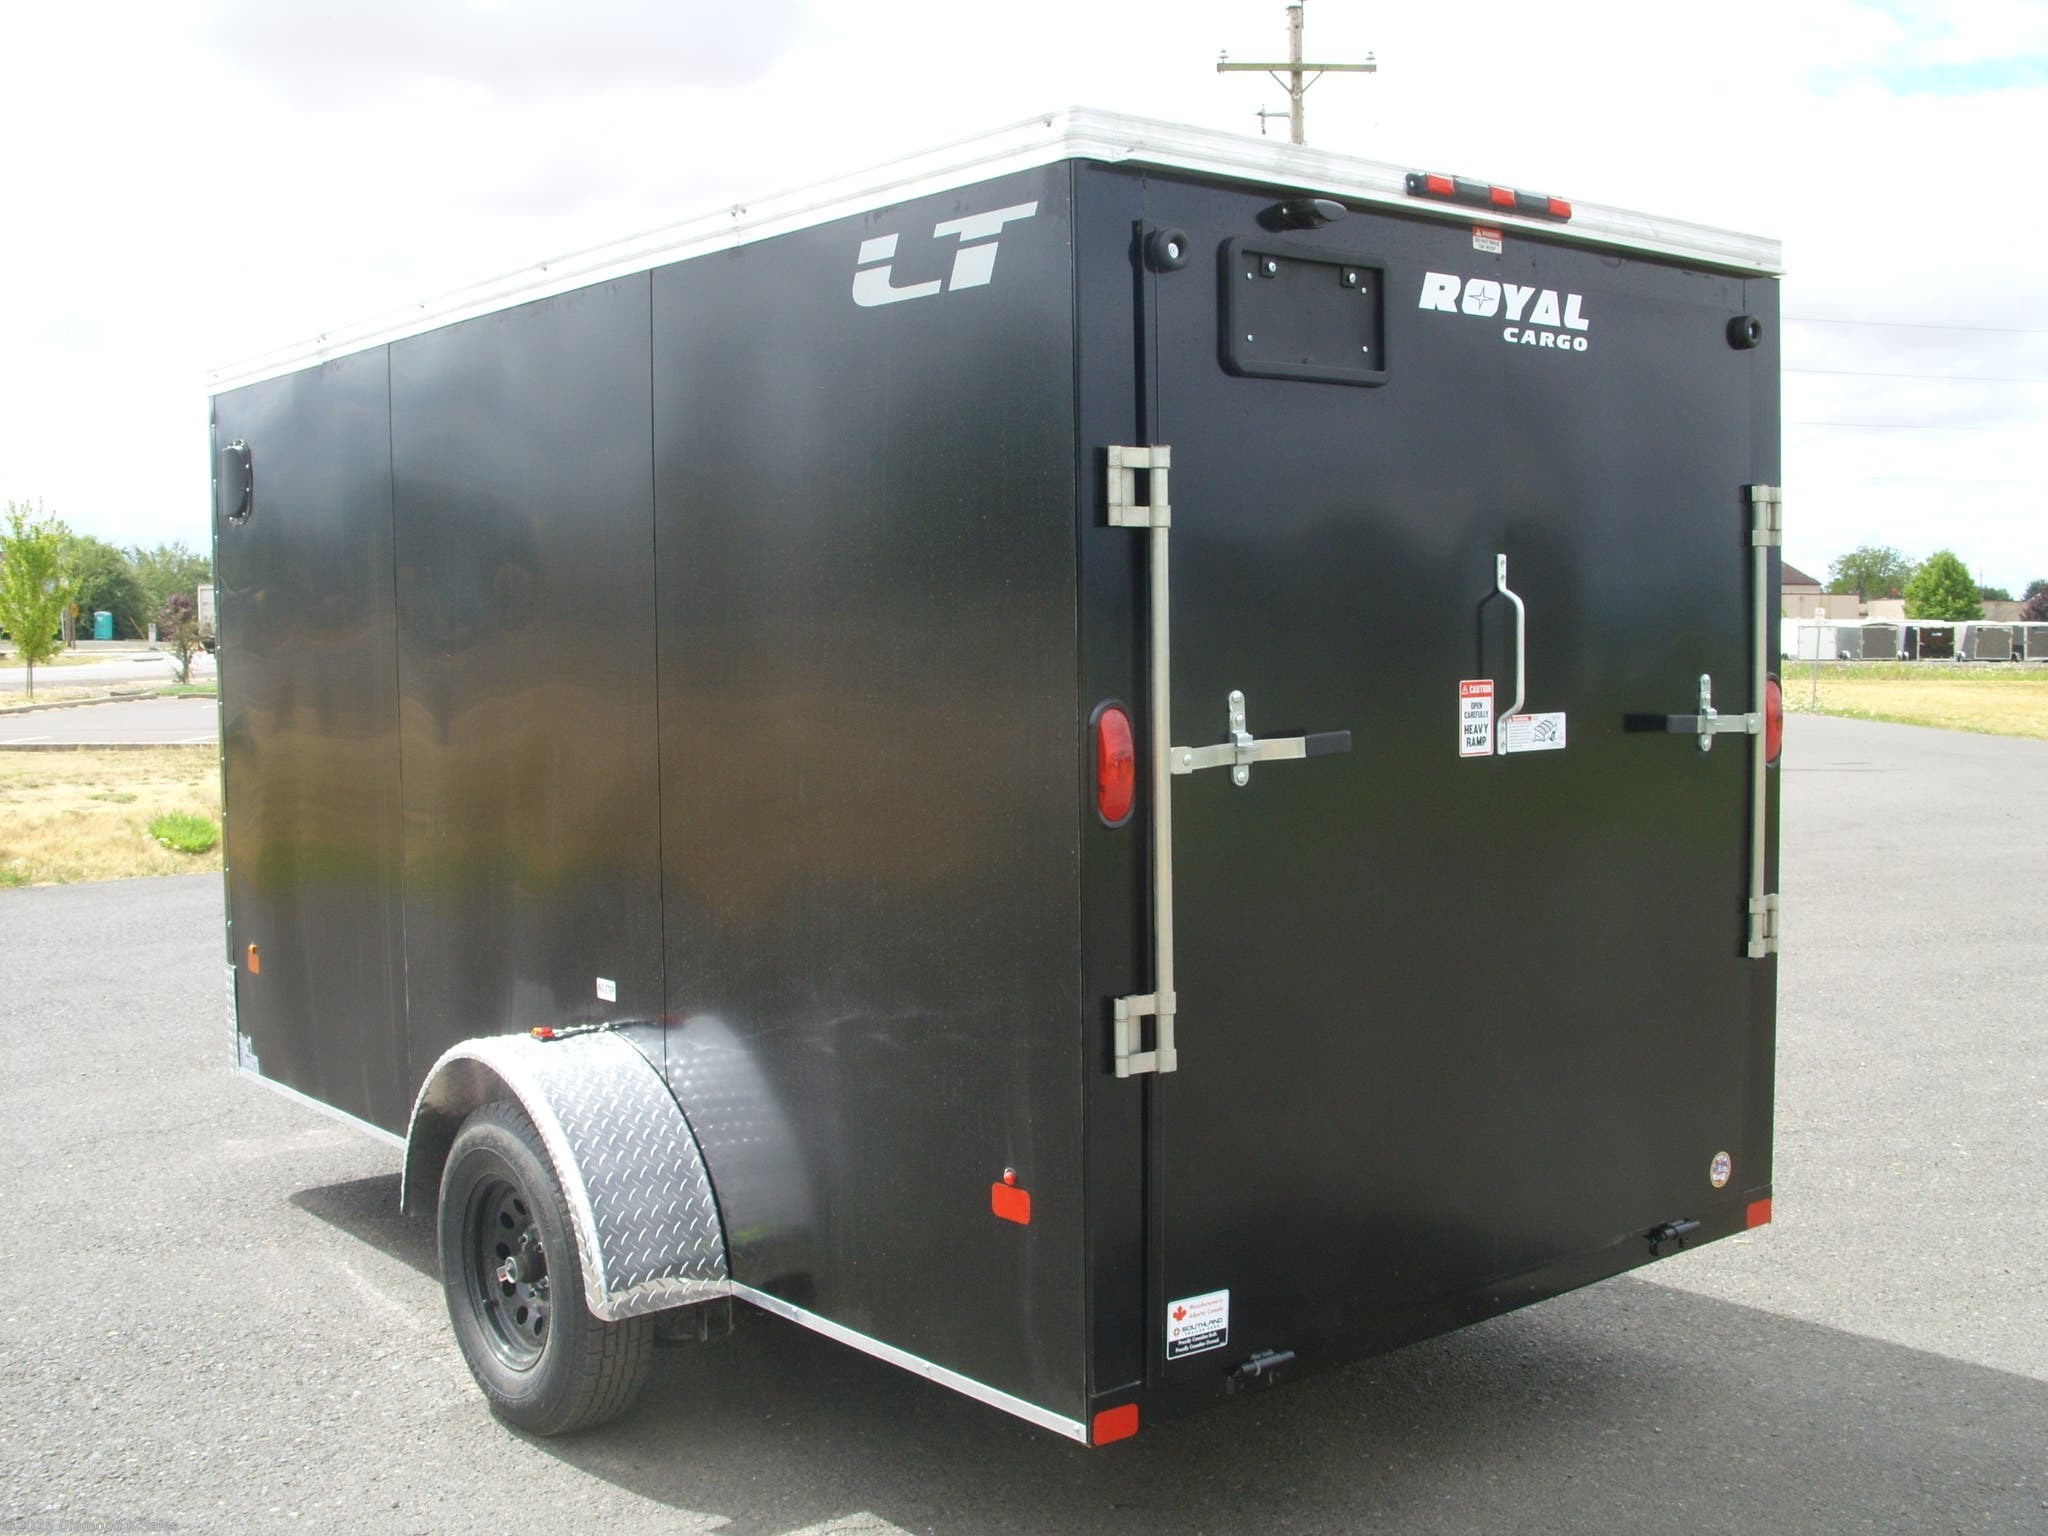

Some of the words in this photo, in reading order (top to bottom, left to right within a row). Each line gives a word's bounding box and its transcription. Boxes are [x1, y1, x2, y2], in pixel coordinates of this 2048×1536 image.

[852, 201, 1039, 307] LT
[1418, 272, 1590, 331] ROYAL
[1503, 327, 1588, 352] CARGO
[1469, 684, 1492, 694] CAUTION
[1470, 702, 1483, 710] OPEN
[1464, 711, 1489, 719] CAREFULLY
[1464, 724, 1489, 735] HEAVY
[1466, 737, 1487, 748] RAMP
[1181, 1317, 1223, 1332] SOUTHLAND
